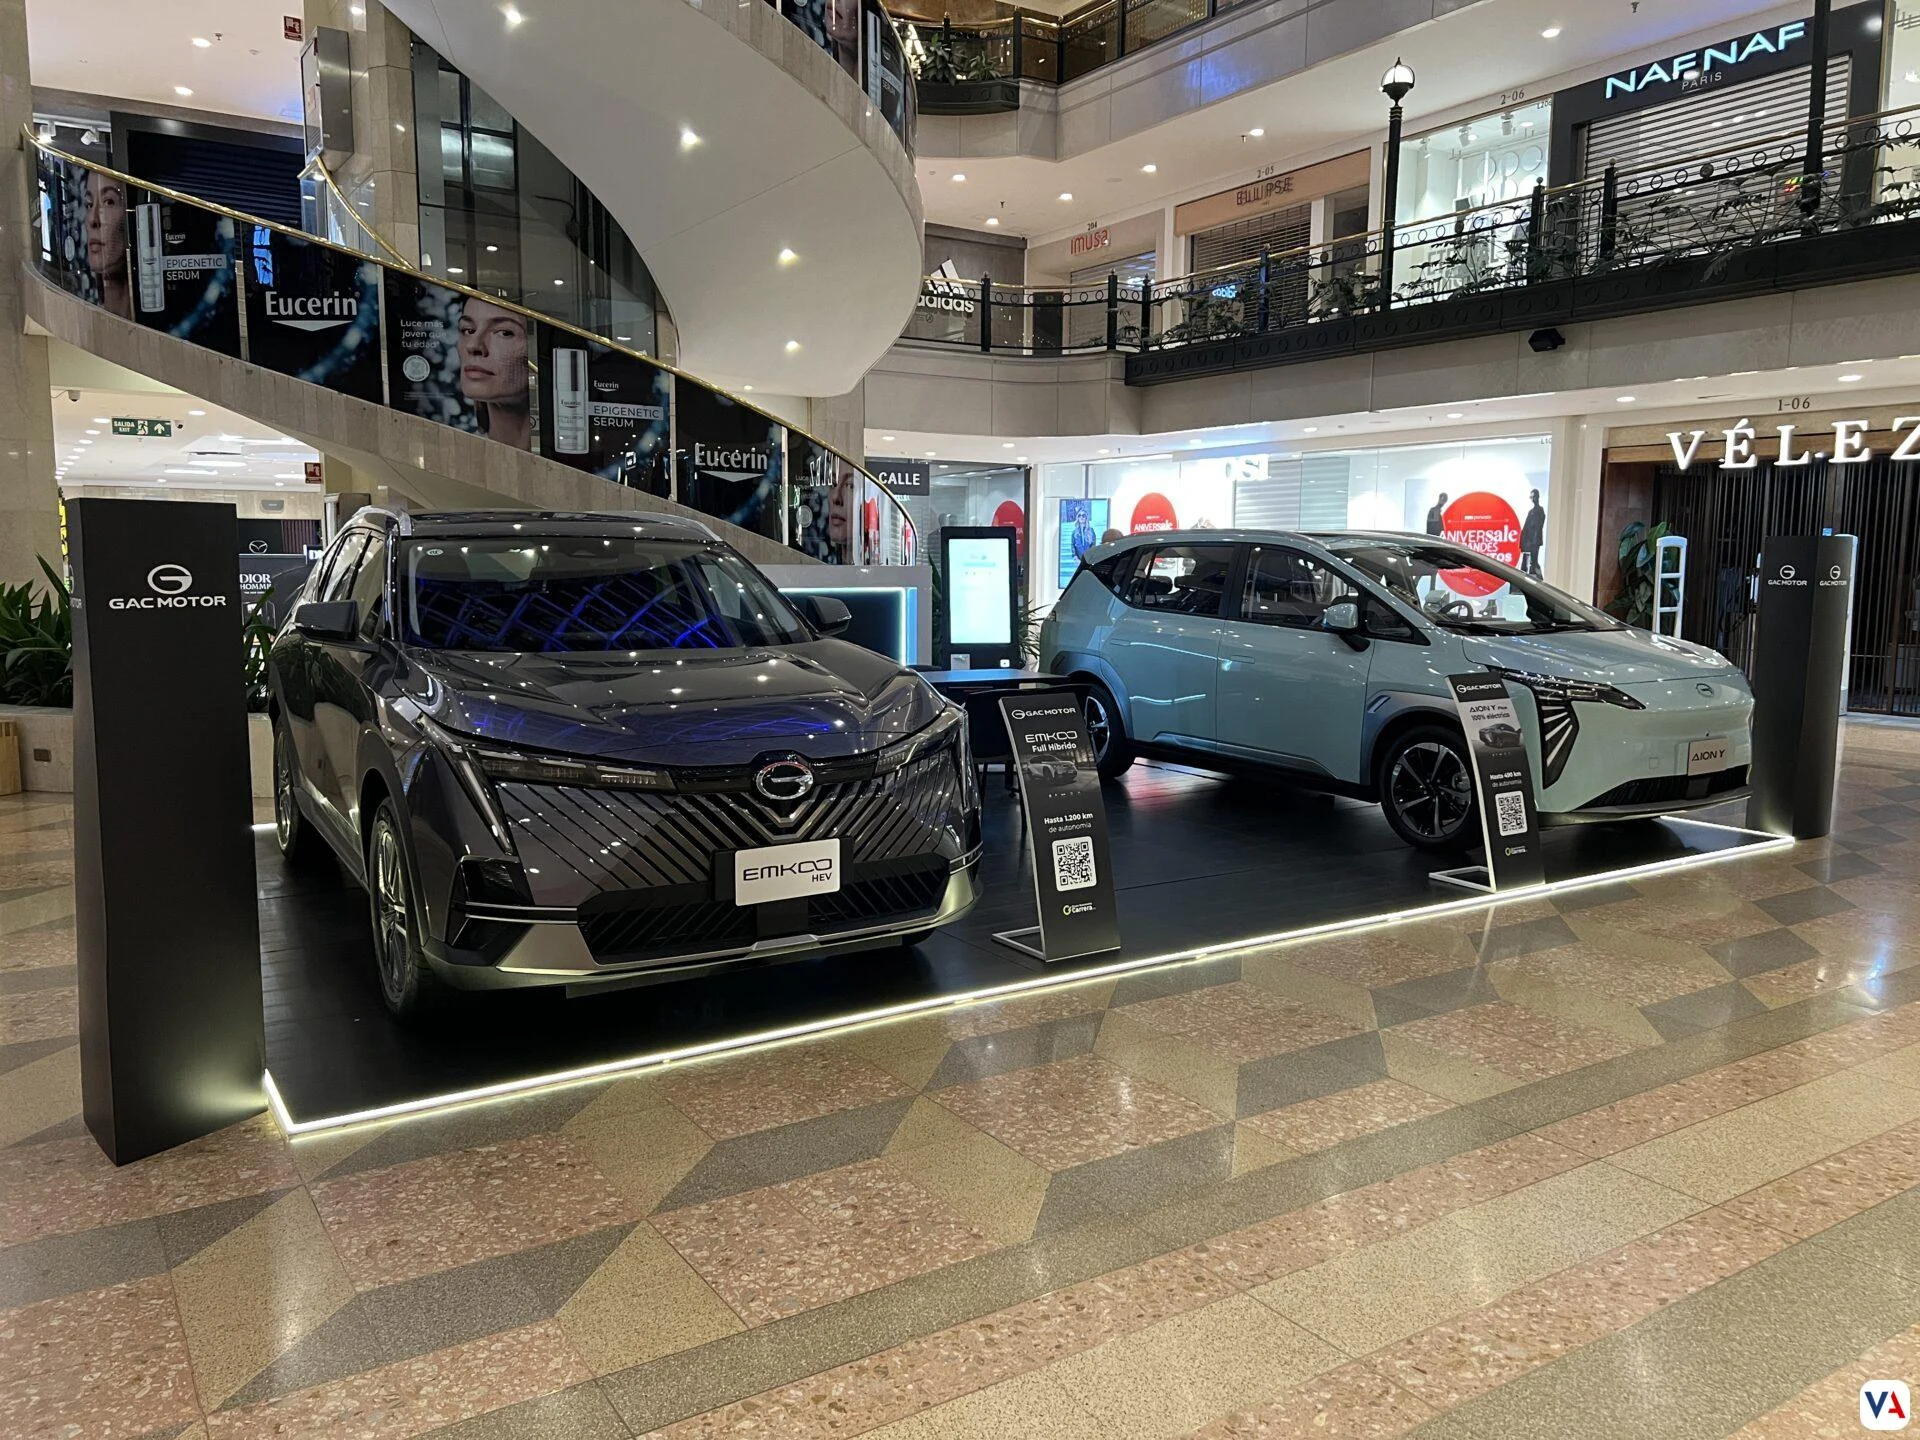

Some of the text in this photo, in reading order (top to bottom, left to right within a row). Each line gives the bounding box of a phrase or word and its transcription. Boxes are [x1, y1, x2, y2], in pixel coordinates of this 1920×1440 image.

[1681, 71, 1723, 91] PARIS
[1500, 89, 1525, 105] 2-06
[1257, 166, 1274, 179] 2-05
[166, 258, 223, 269] EPIGENETIC
[166, 270, 201, 281] SERUM
[265, 291, 358, 316] Eucerin
[400, 319, 422, 328] Luce
[402, 330, 427, 339] joven
[1777, 397, 1811, 412] 1-06
[594, 405, 660, 418] EPIGENETIC
[593, 416, 634, 428] SERUM
[1666, 418, 1920, 471] VÉLEZ
[695, 442, 768, 470] Eucerin
[878, 471, 921, 486] CALLE
[240, 573, 271, 584] DIOR
[109, 596, 227, 609] GAC MOTOR
[1045, 707, 1076, 716] MOTOR
[1025, 730, 1078, 743] EMKOO
[1031, 742, 1077, 752] Full Híbrido
[1719, 749, 1725, 758] Y
[1044, 816, 1063, 825] Hasta
[1082, 812, 1094, 820] km
[743, 858, 832, 881] EMKOO
[811, 872, 833, 883] HEV
